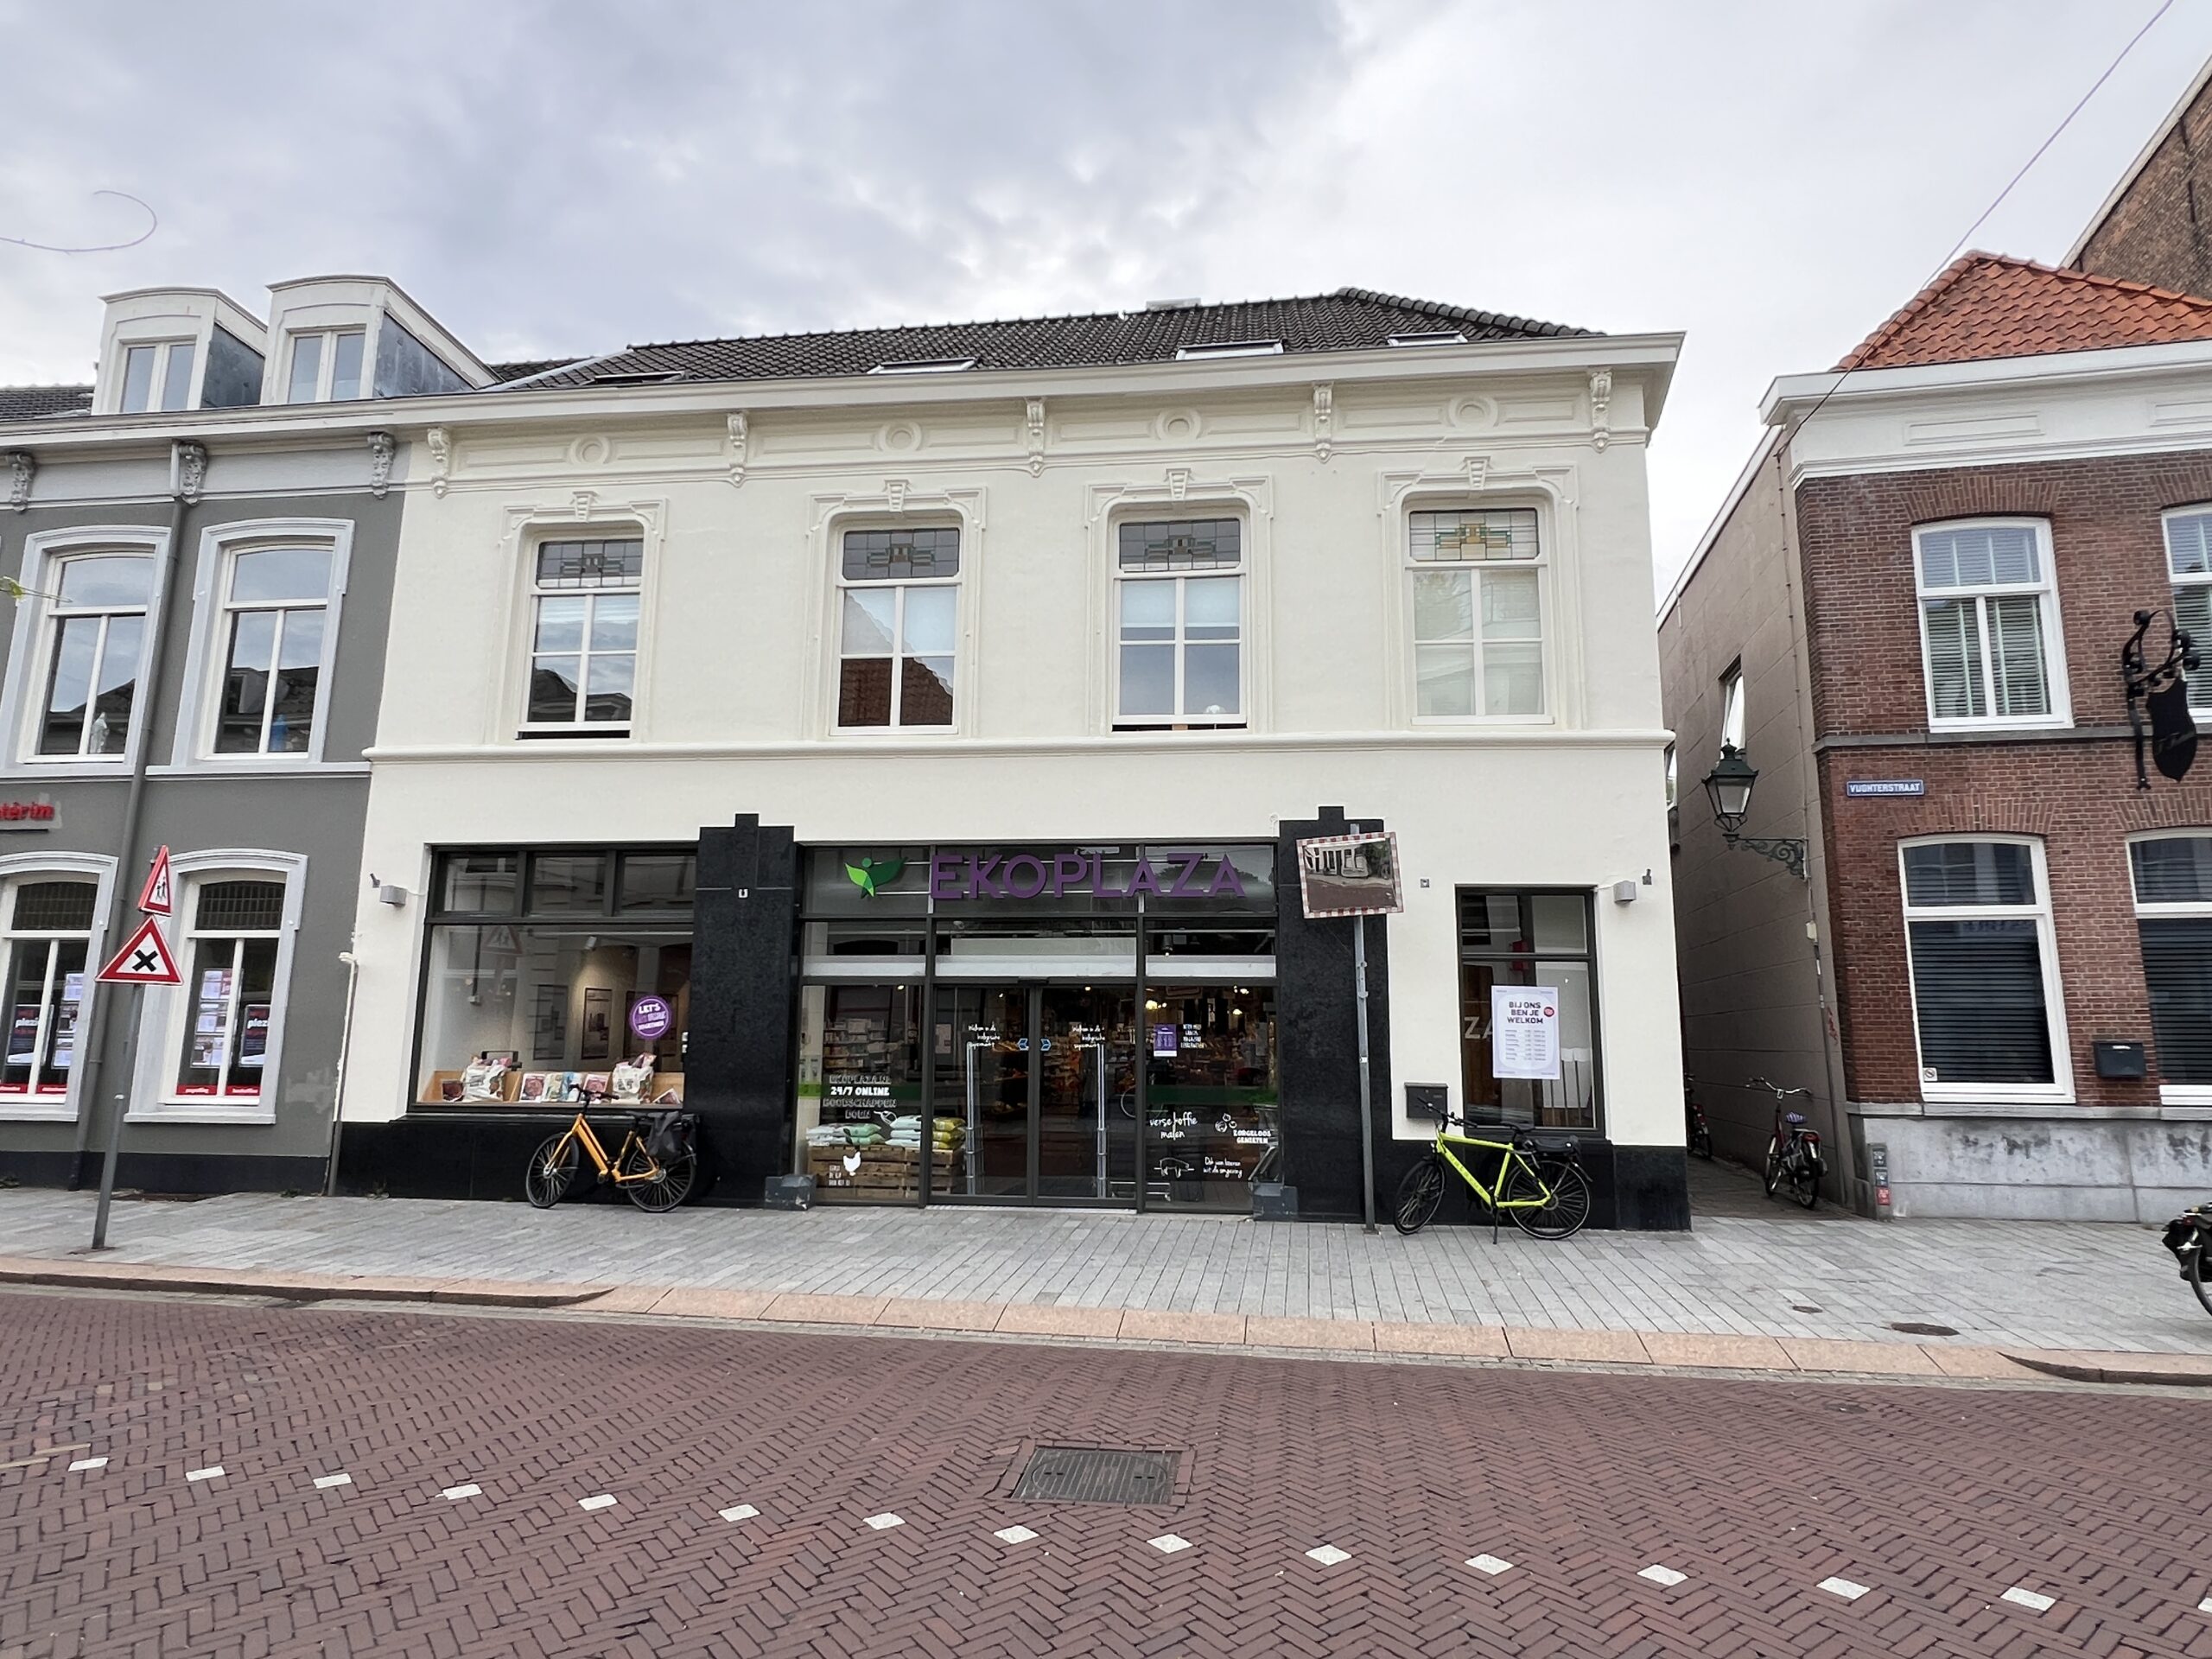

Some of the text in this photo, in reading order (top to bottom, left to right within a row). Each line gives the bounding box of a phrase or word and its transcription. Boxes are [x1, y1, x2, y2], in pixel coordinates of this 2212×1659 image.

[931, 852, 1246, 899] EKOPLAZA
[830, 1086, 890, 1096] 24/7 ONLINE
[1149, 1118, 1173, 1127] verse
